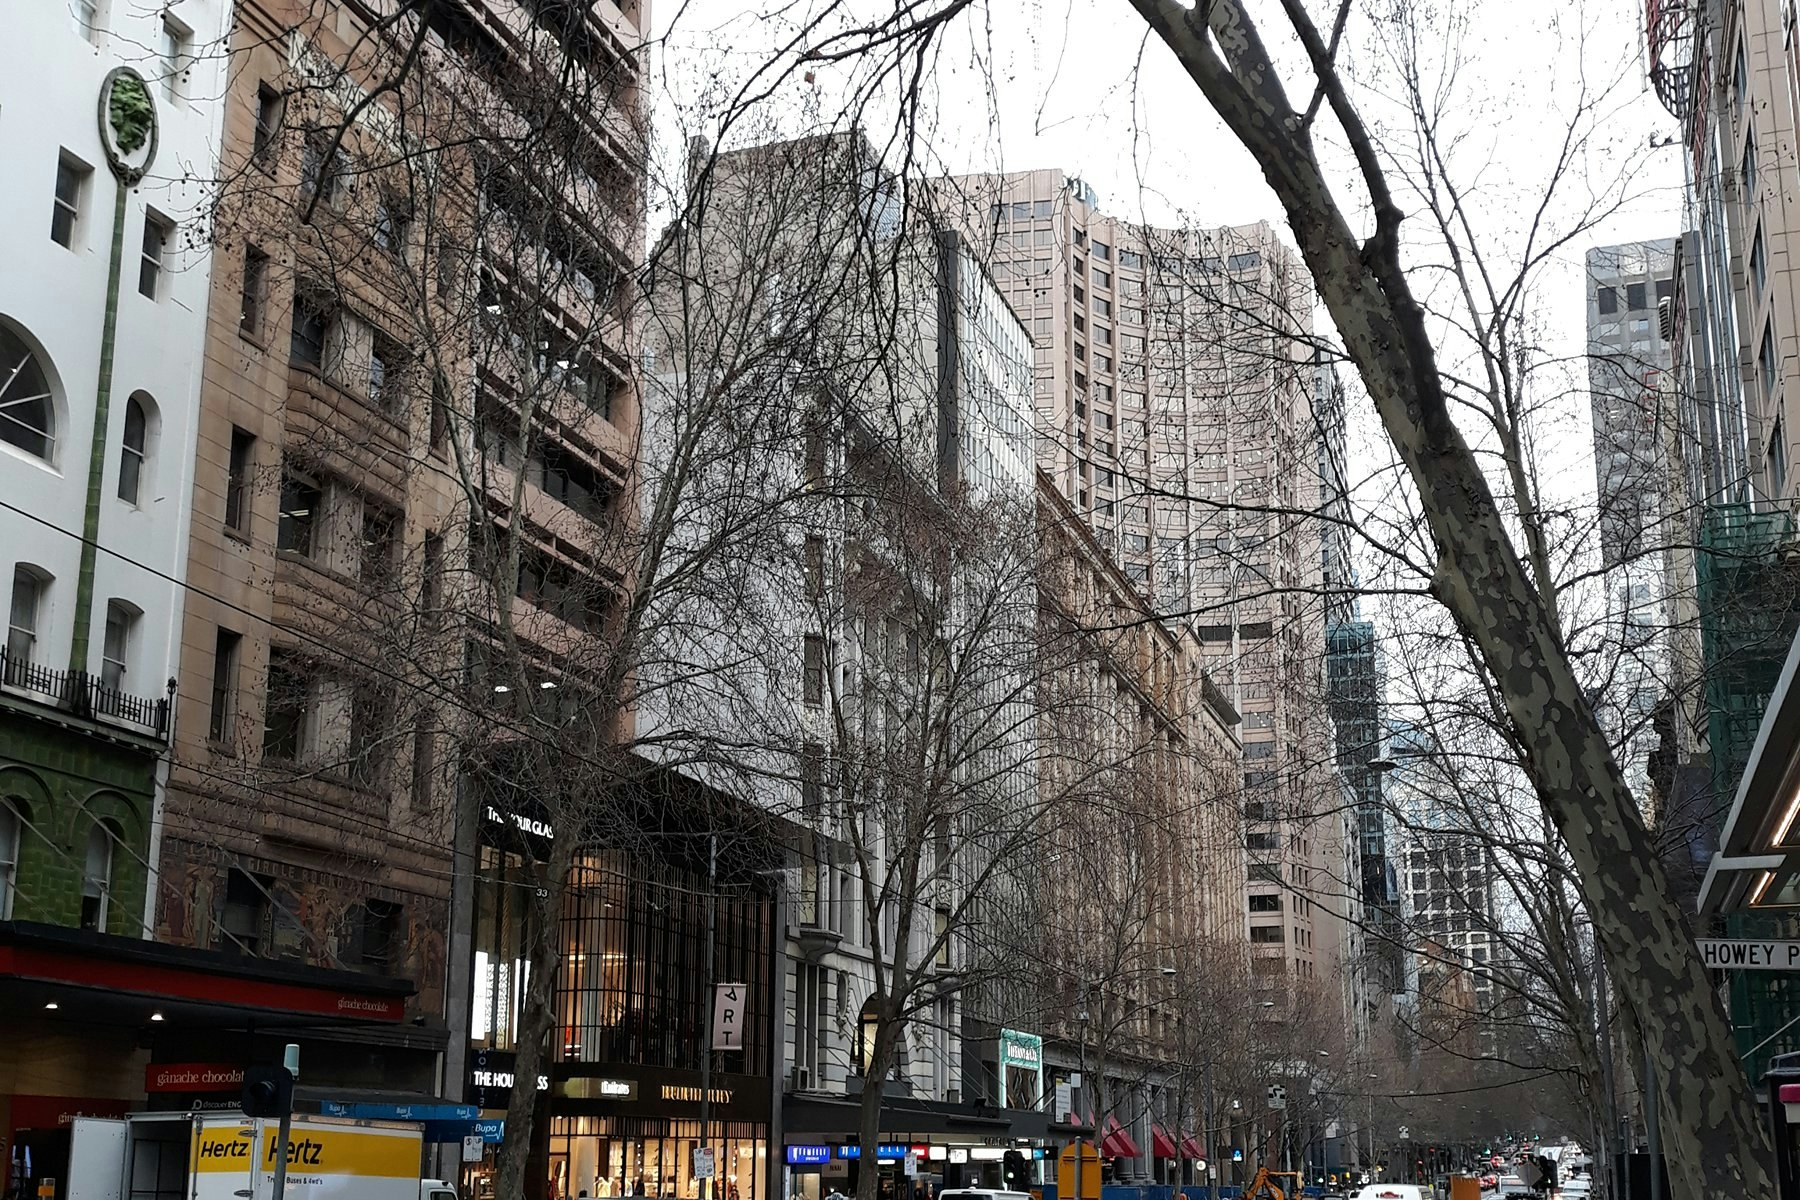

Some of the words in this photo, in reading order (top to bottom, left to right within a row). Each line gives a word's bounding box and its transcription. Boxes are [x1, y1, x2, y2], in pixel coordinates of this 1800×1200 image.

[531, 820, 554, 839] GLAS
[536, 888, 548, 897] 33
[1704, 943, 1775, 965] HOWEY
[722, 986, 737, 1046] ART
[202, 1069, 244, 1083] chocolat
[474, 1071, 492, 1086] THE
[493, 1073, 514, 1088] HOU
[227, 1101, 242, 1109] ENG
[475, 1123, 497, 1133] Bupa
[200, 1140, 249, 1157] Hertz
